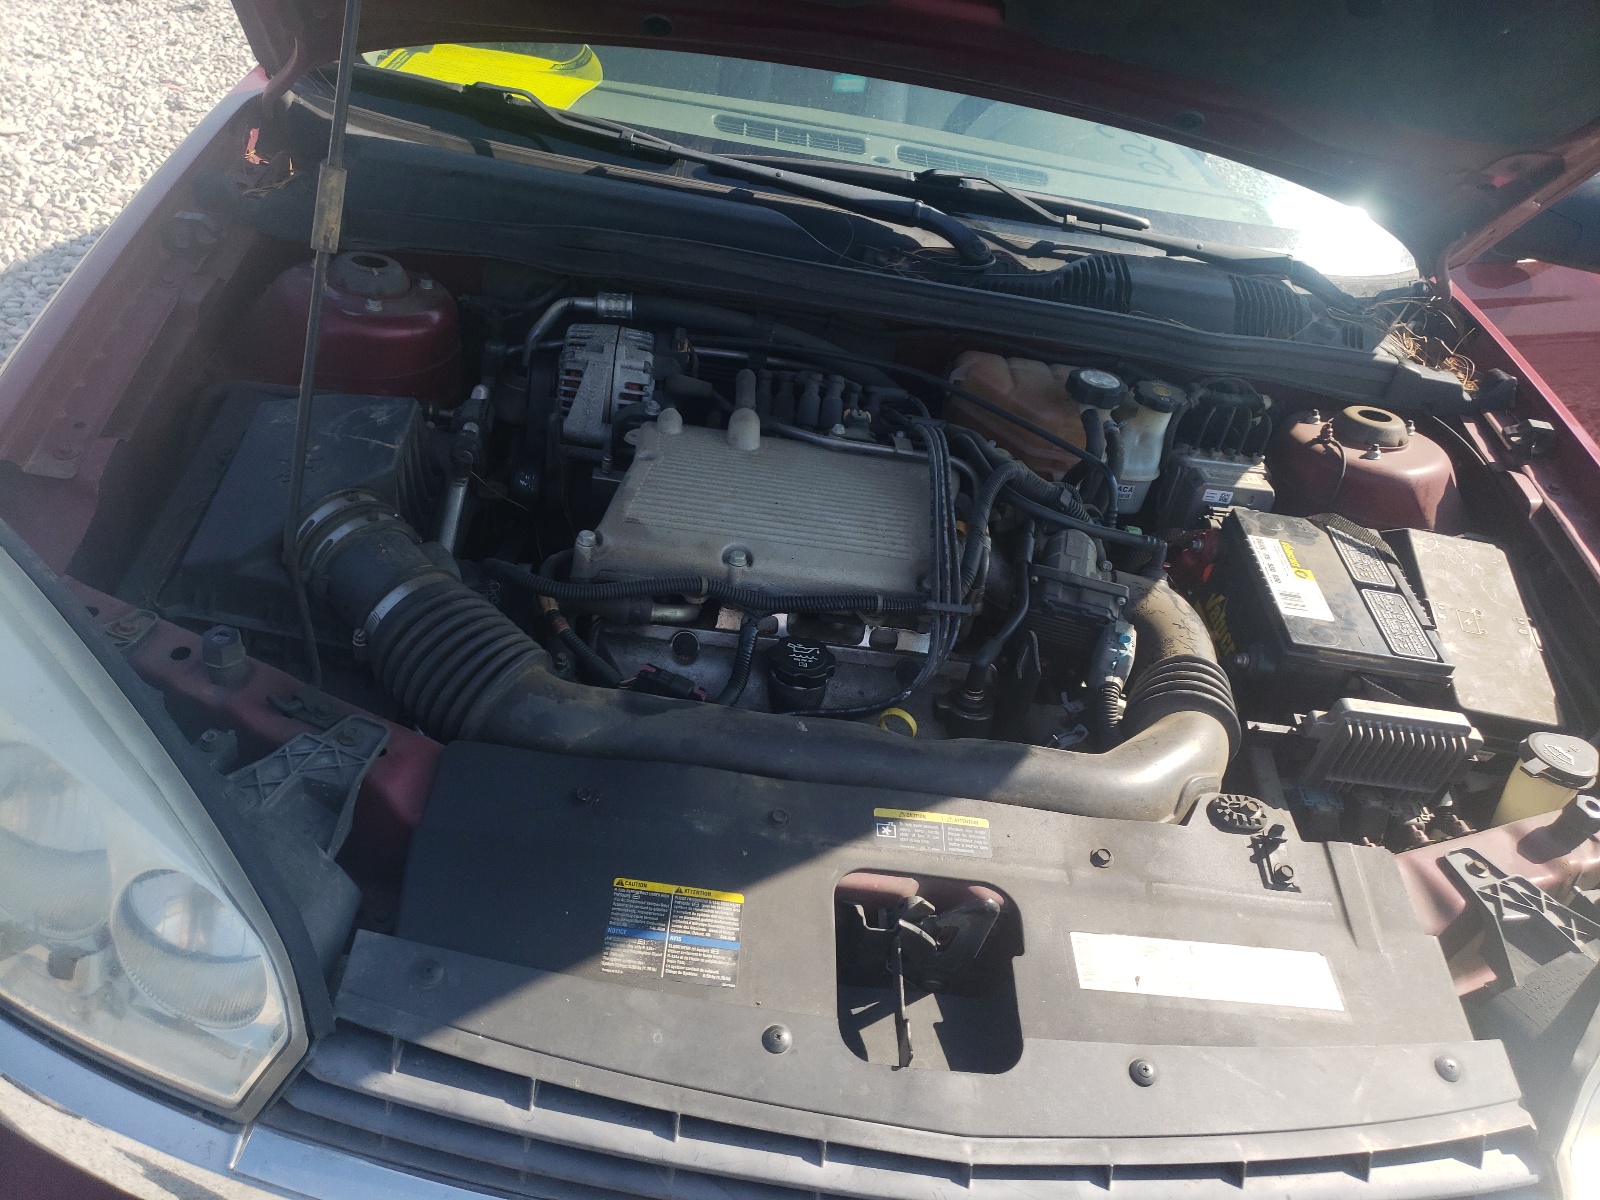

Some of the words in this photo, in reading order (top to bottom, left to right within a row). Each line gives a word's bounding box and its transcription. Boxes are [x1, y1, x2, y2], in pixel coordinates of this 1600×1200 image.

[624, 880, 648, 888] CAUTION
[684, 888, 712, 897] ATTENTION
[607, 927, 627, 935] NOTICE
